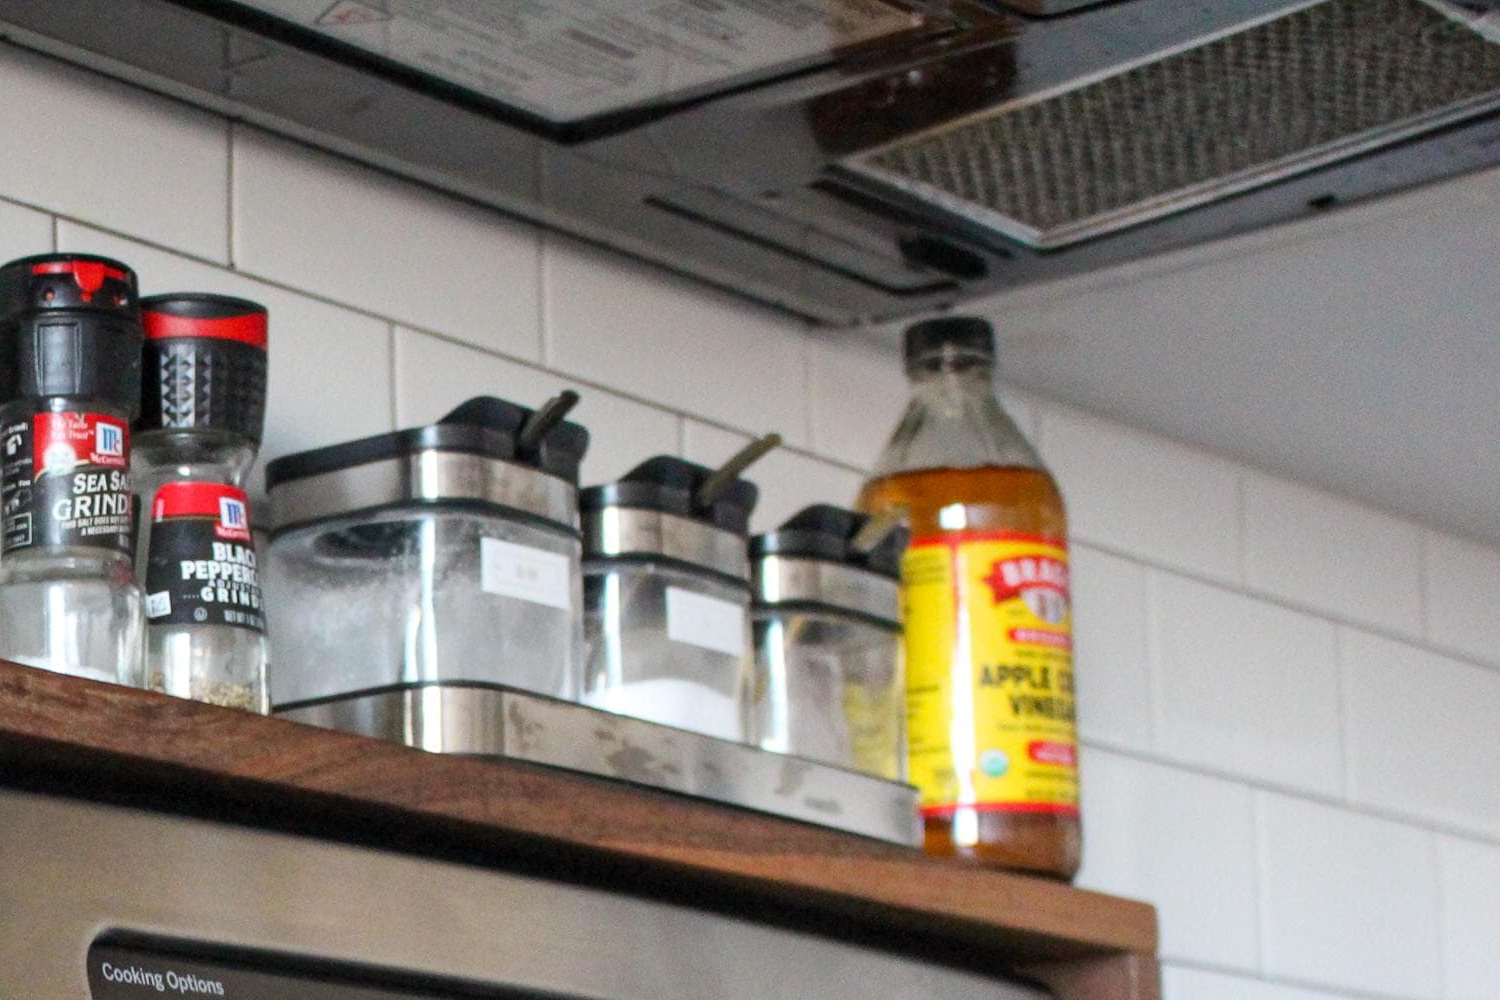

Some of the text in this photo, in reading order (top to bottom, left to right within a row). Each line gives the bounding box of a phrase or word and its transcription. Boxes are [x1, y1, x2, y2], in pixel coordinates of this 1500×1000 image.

[73, 472, 107, 494] SEA
[102, 962, 225, 996] Cooking Options
